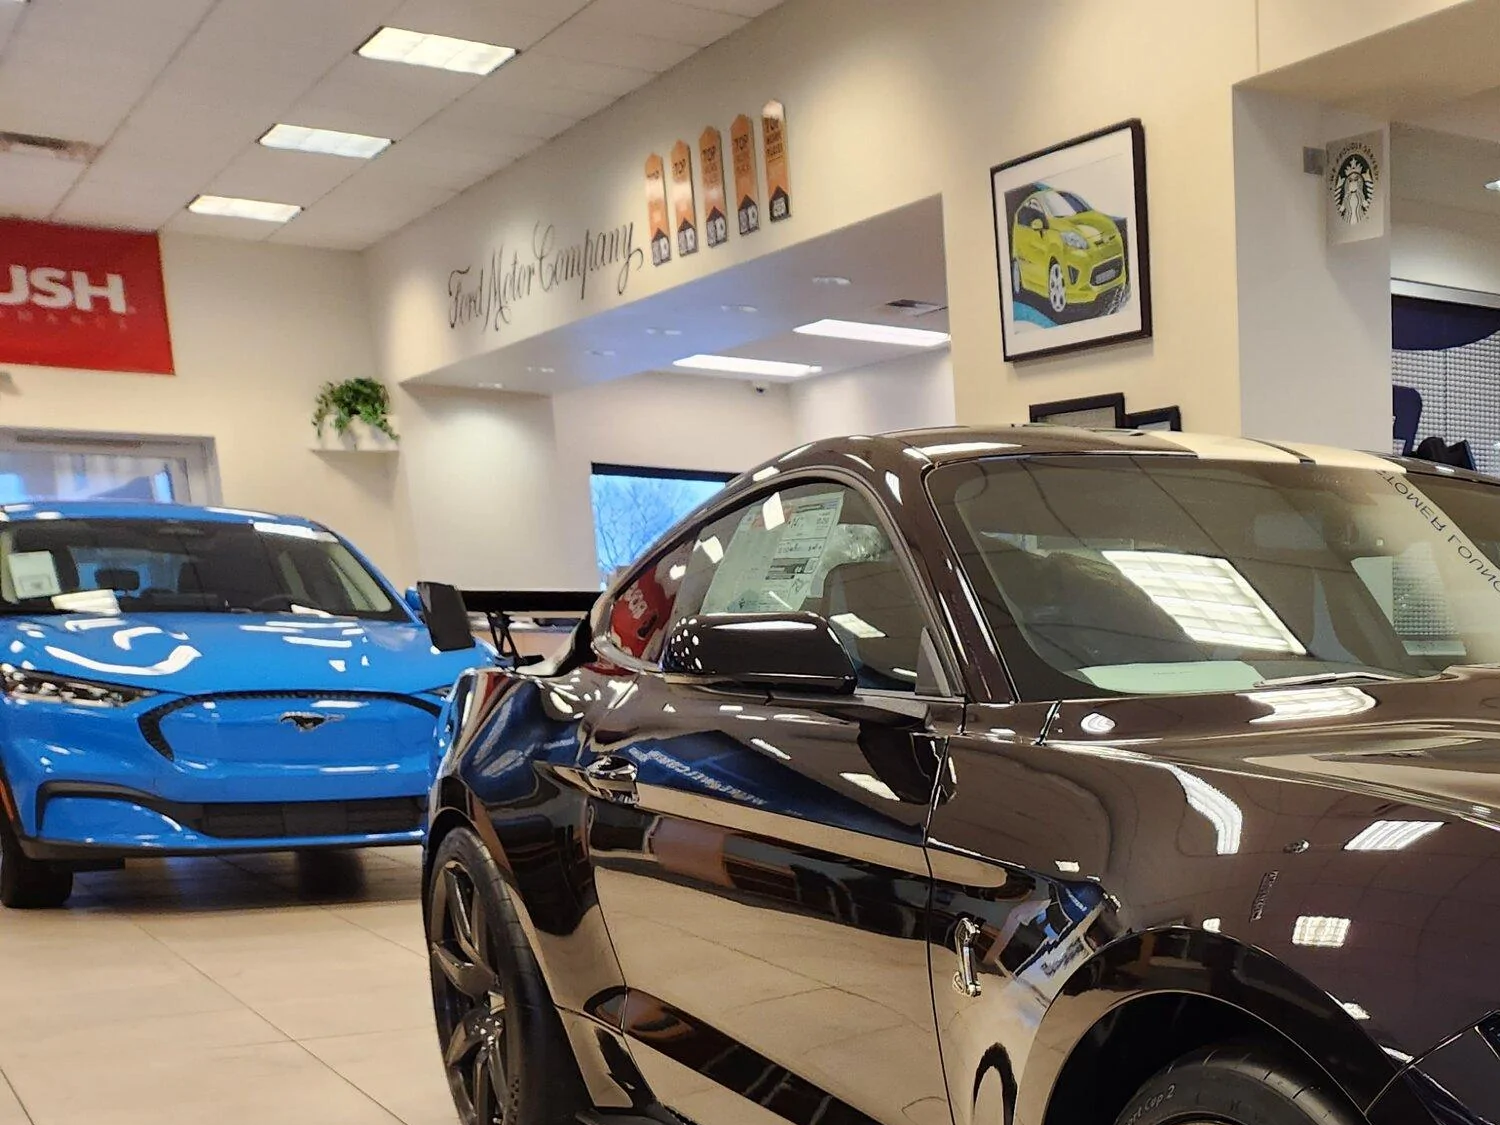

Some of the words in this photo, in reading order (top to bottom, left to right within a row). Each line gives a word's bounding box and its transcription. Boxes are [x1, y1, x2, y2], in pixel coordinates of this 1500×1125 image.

[448, 264, 484, 329] Ford
[483, 244, 535, 332] Motor
[533, 220, 644, 300] Company
[1165, 1083, 1176, 1100] 2
